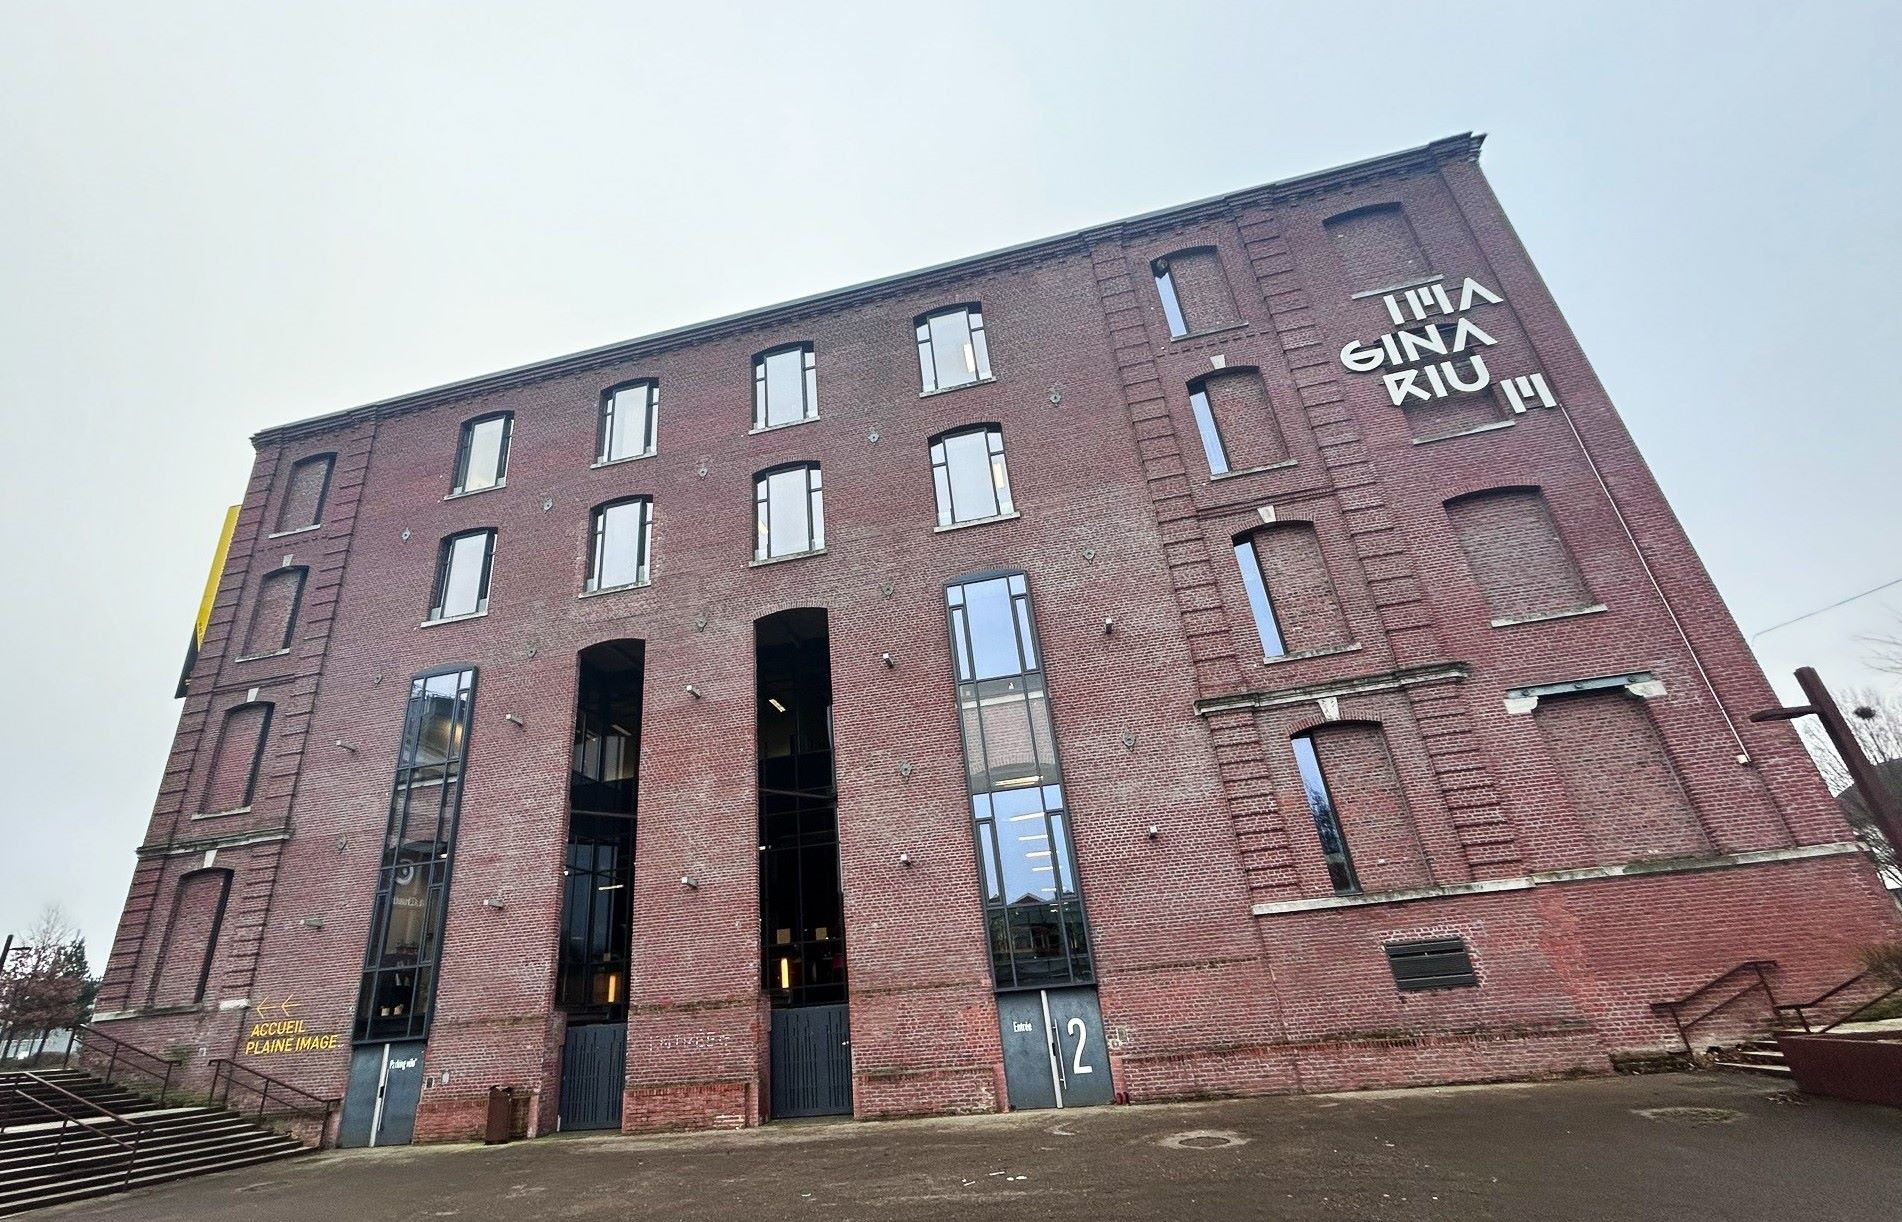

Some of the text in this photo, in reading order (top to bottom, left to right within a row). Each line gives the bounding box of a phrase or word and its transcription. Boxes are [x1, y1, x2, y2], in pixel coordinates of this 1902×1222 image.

[1340, 317, 1498, 372] GINA
[245, 1034, 338, 1055] PLAINE IMAGE
[250, 1019, 306, 1037] ACCUEIL
[1067, 1017, 1093, 1075] 2
